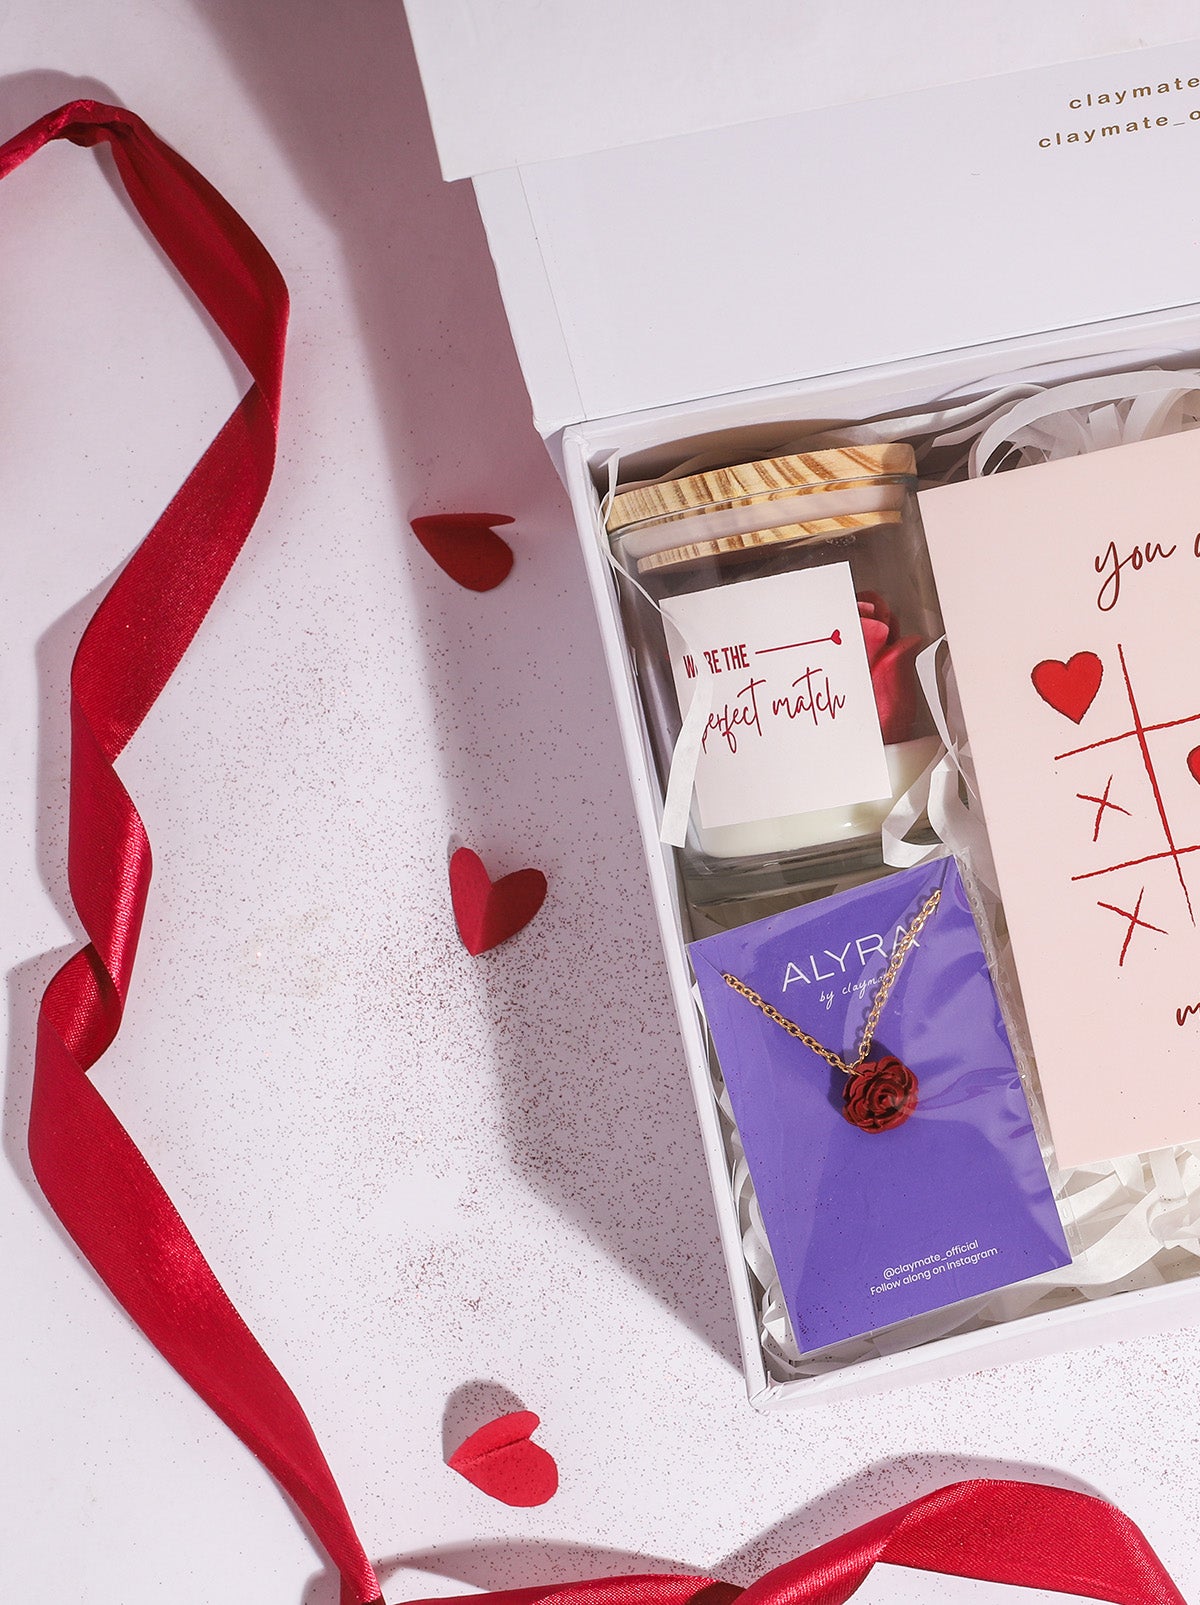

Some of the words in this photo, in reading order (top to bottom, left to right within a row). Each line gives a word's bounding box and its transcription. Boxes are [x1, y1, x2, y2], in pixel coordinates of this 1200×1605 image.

[1094, 541, 1177, 611] you
[721, 643, 750, 671] THE
[772, 667, 846, 726] match
[782, 925, 920, 992] ALYRA
[819, 991, 834, 1010] by
[870, 1280, 901, 1295] Follow
[902, 1269, 931, 1285] along
[932, 1264, 946, 1275] on
[946, 1247, 998, 1270] Instagram
[883, 1239, 979, 1280] @claymate_official
